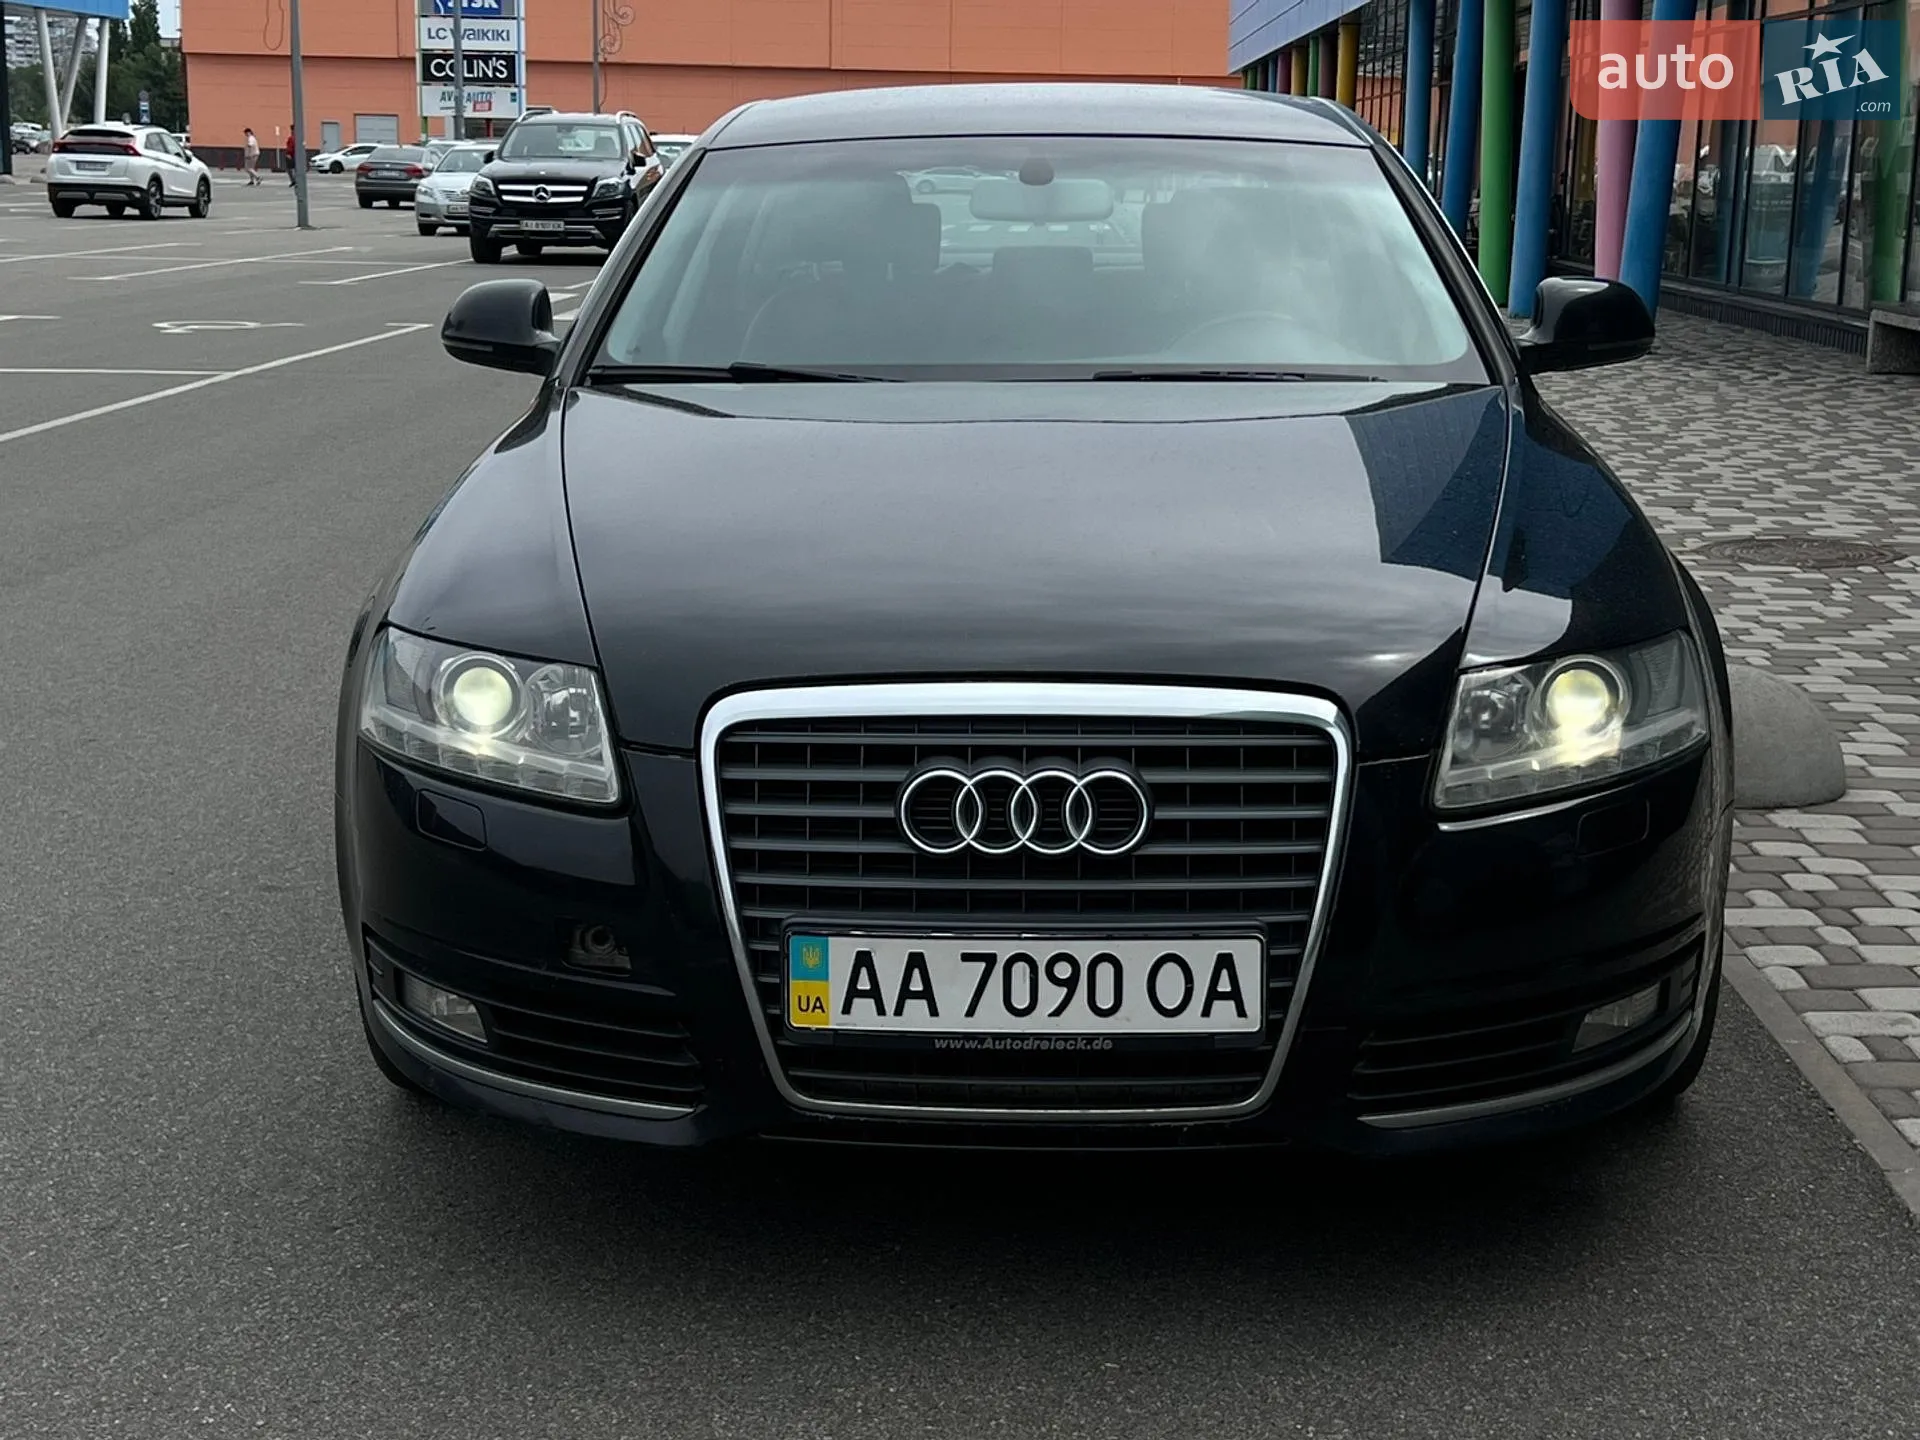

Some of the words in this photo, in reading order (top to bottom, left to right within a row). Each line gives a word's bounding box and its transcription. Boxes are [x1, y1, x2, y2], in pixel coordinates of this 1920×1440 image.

[427, 27, 448, 40] LC
[430, 57, 508, 78] COLIN'S
[840, 950, 940, 1017] AA
[960, 951, 1124, 1018] 7090
[1146, 952, 1248, 1018] OA
[797, 995, 826, 1014] UA
